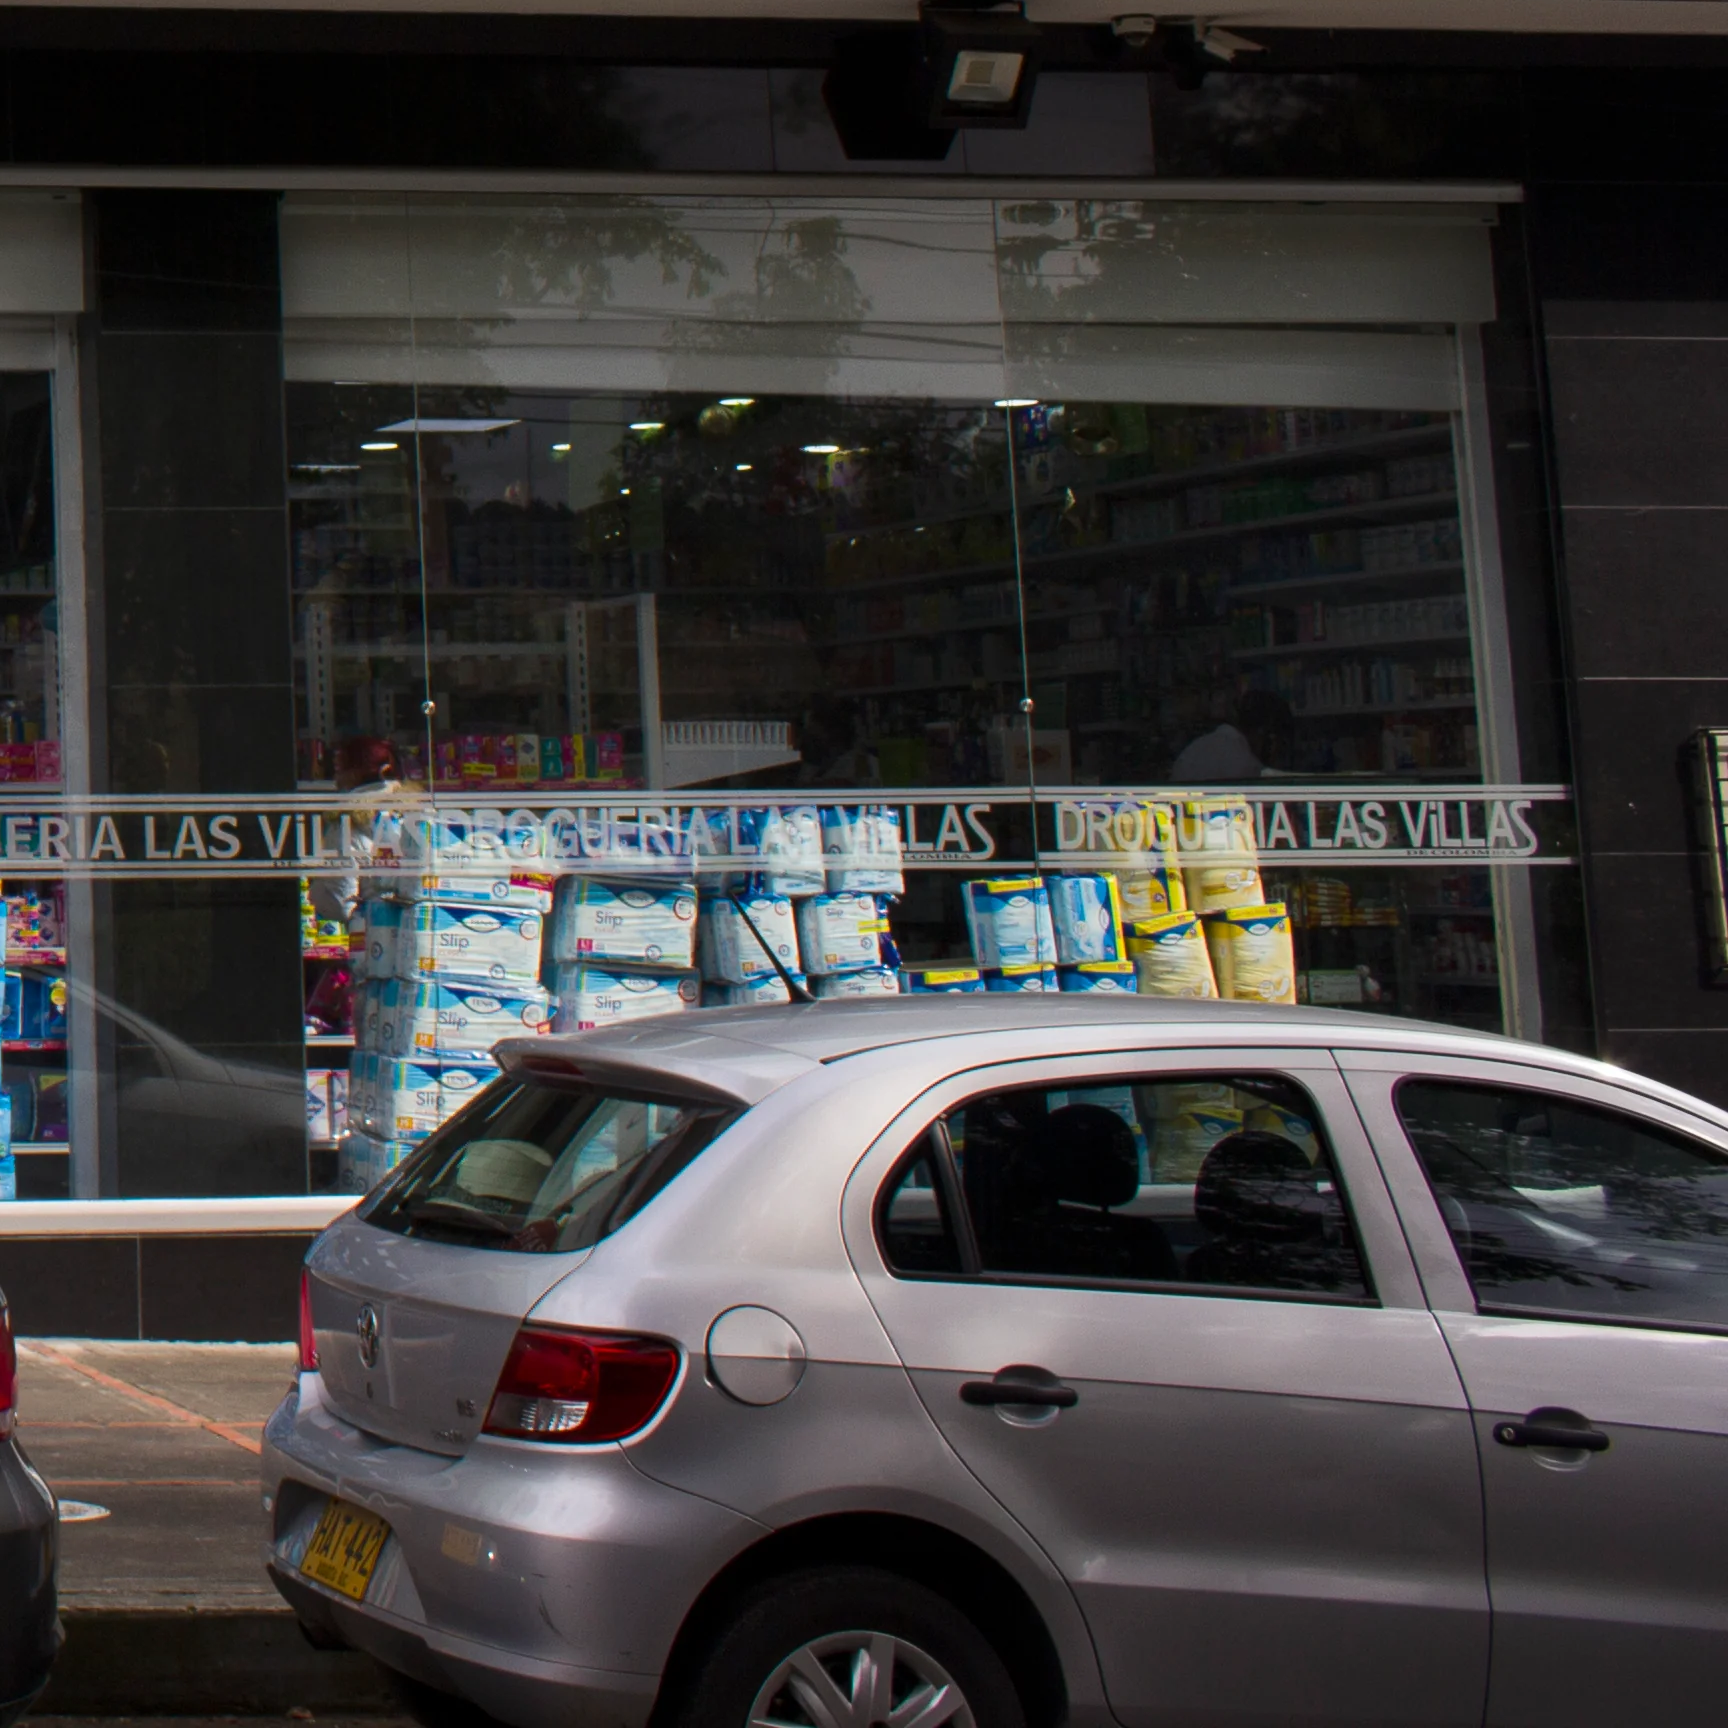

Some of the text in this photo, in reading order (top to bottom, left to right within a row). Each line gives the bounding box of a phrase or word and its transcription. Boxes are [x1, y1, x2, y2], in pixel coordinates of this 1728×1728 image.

[1055, 799, 1298, 852] DROGUERIA
[1307, 800, 1388, 849] LAS
[144, 814, 243, 862] LAS
[594, 909, 624, 928] Slip
[439, 933, 470, 950] Slip
[594, 995, 623, 1012] Slip
[438, 1011, 468, 1030] Slip
